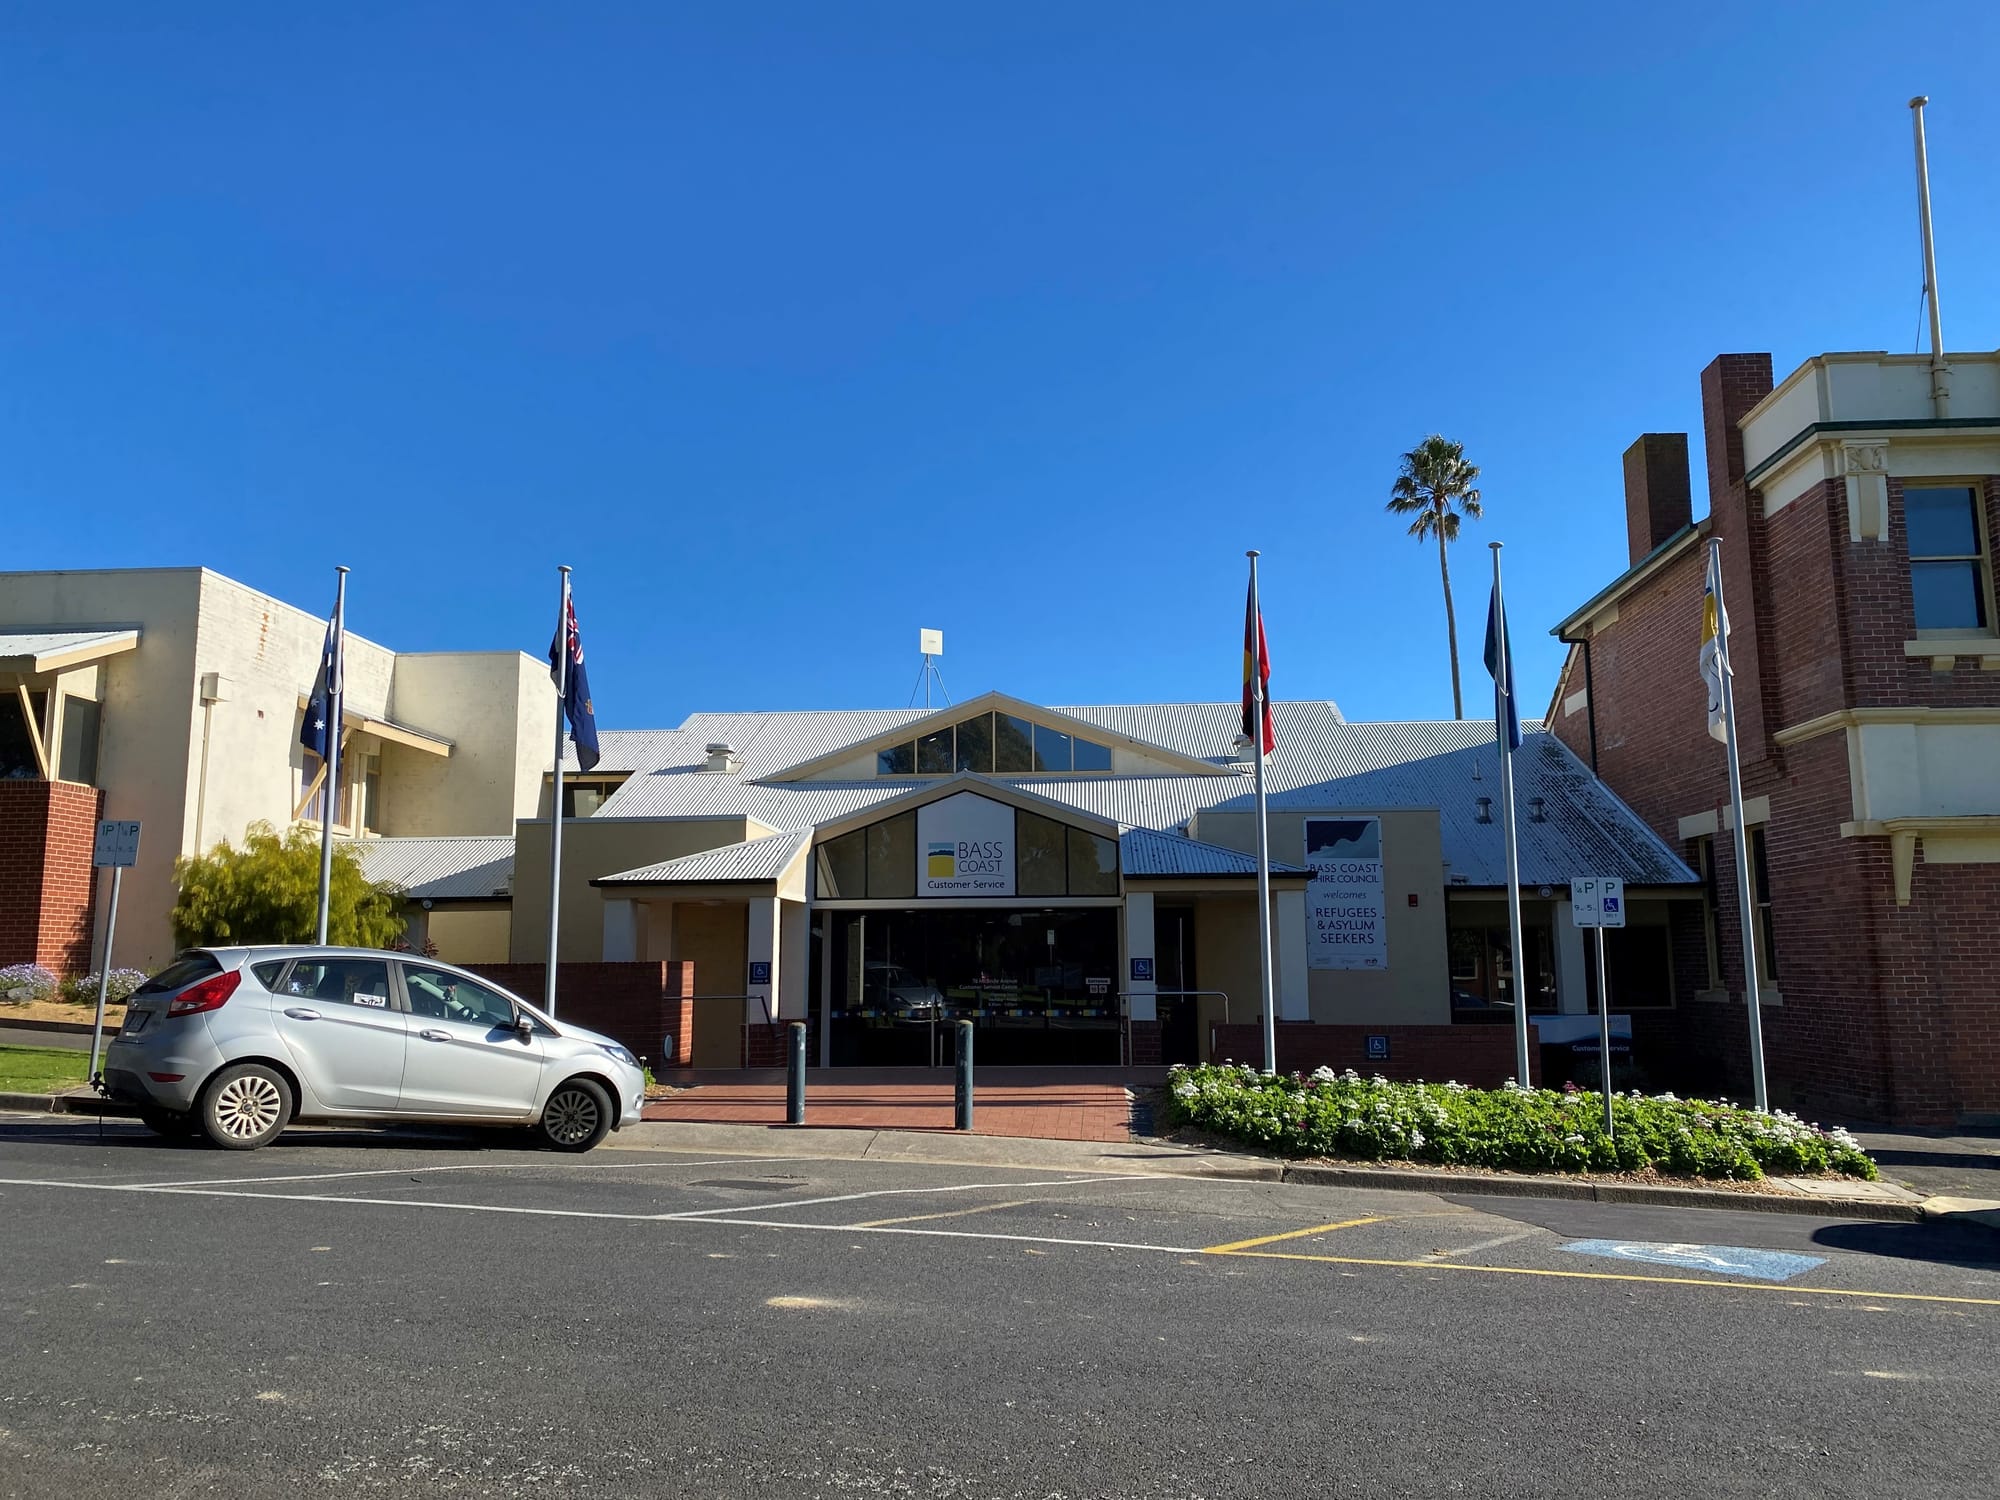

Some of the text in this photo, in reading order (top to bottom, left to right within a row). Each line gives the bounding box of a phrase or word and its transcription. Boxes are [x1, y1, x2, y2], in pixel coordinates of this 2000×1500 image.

[958, 842, 1003, 859] BASS
[958, 860, 1002, 872] COAST
[1310, 864, 1379, 873] BASS COAST
[1337, 875, 1379, 883] COUNCIL
[928, 880, 1005, 889] Customer Service
[1605, 882, 1616, 894] P
[1323, 890, 1367, 899] welcomes
[1316, 908, 1377, 918] REFUGEES
[1317, 920, 1375, 930] & ASYLUM
[1320, 933, 1375, 943] SEEKERS
